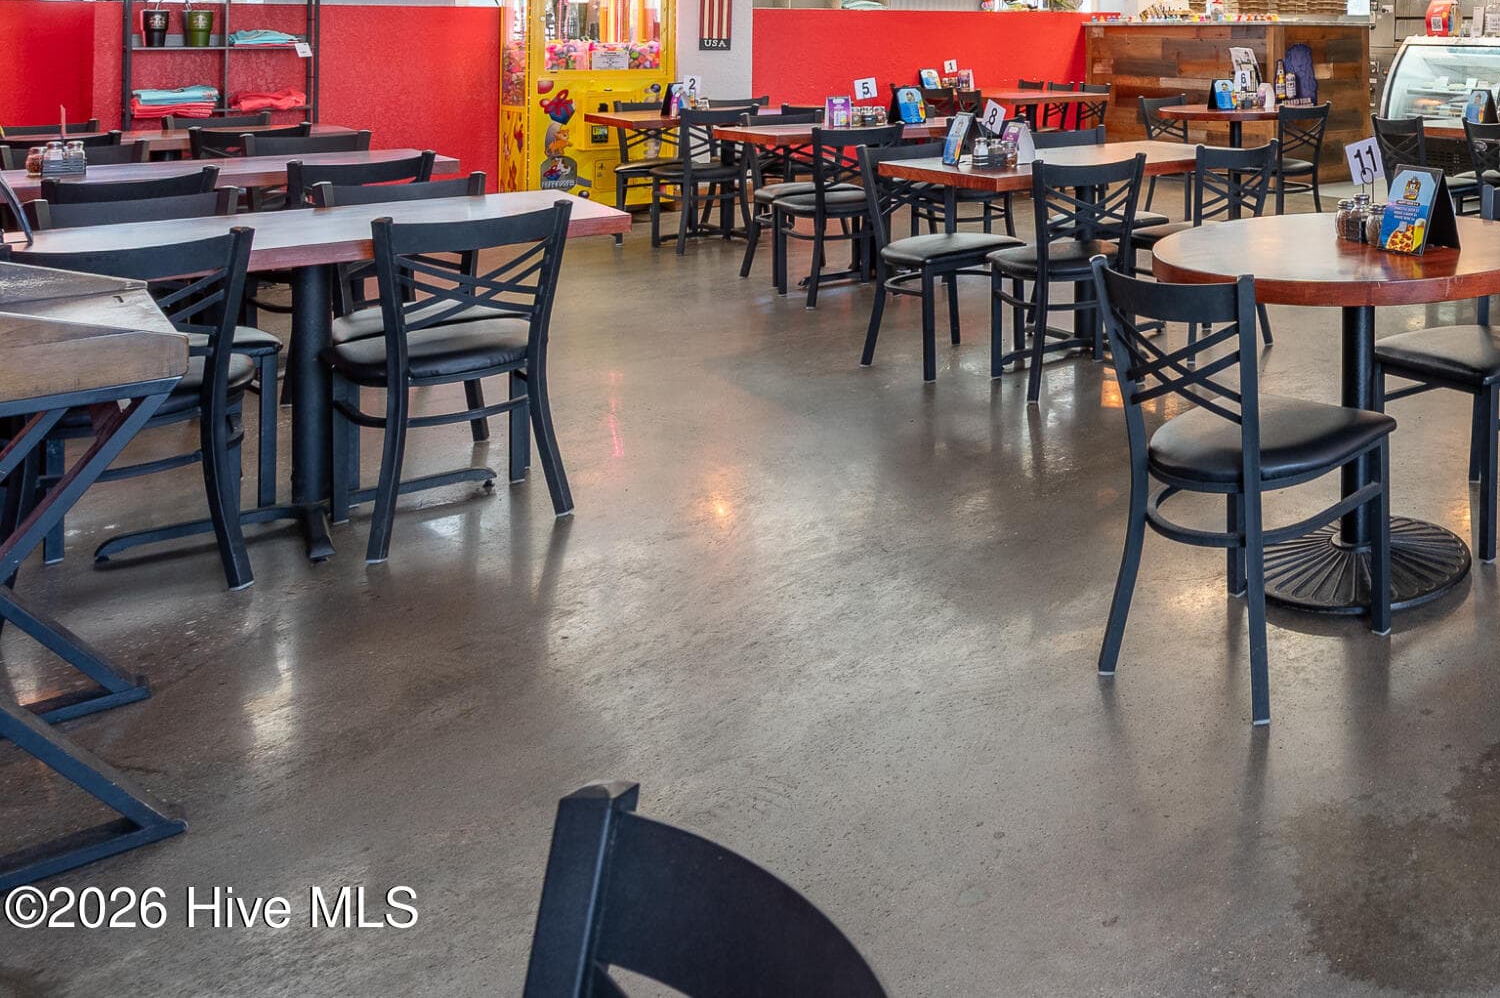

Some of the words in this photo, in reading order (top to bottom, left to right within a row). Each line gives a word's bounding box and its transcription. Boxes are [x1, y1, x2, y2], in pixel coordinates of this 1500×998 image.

[704, 39, 727, 48] USA
[689, 78, 696, 90] 2
[1241, 73, 1247, 84] 6
[862, 81, 870, 95] 5
[989, 107, 998, 125] 8
[1353, 145, 1377, 175] 11
